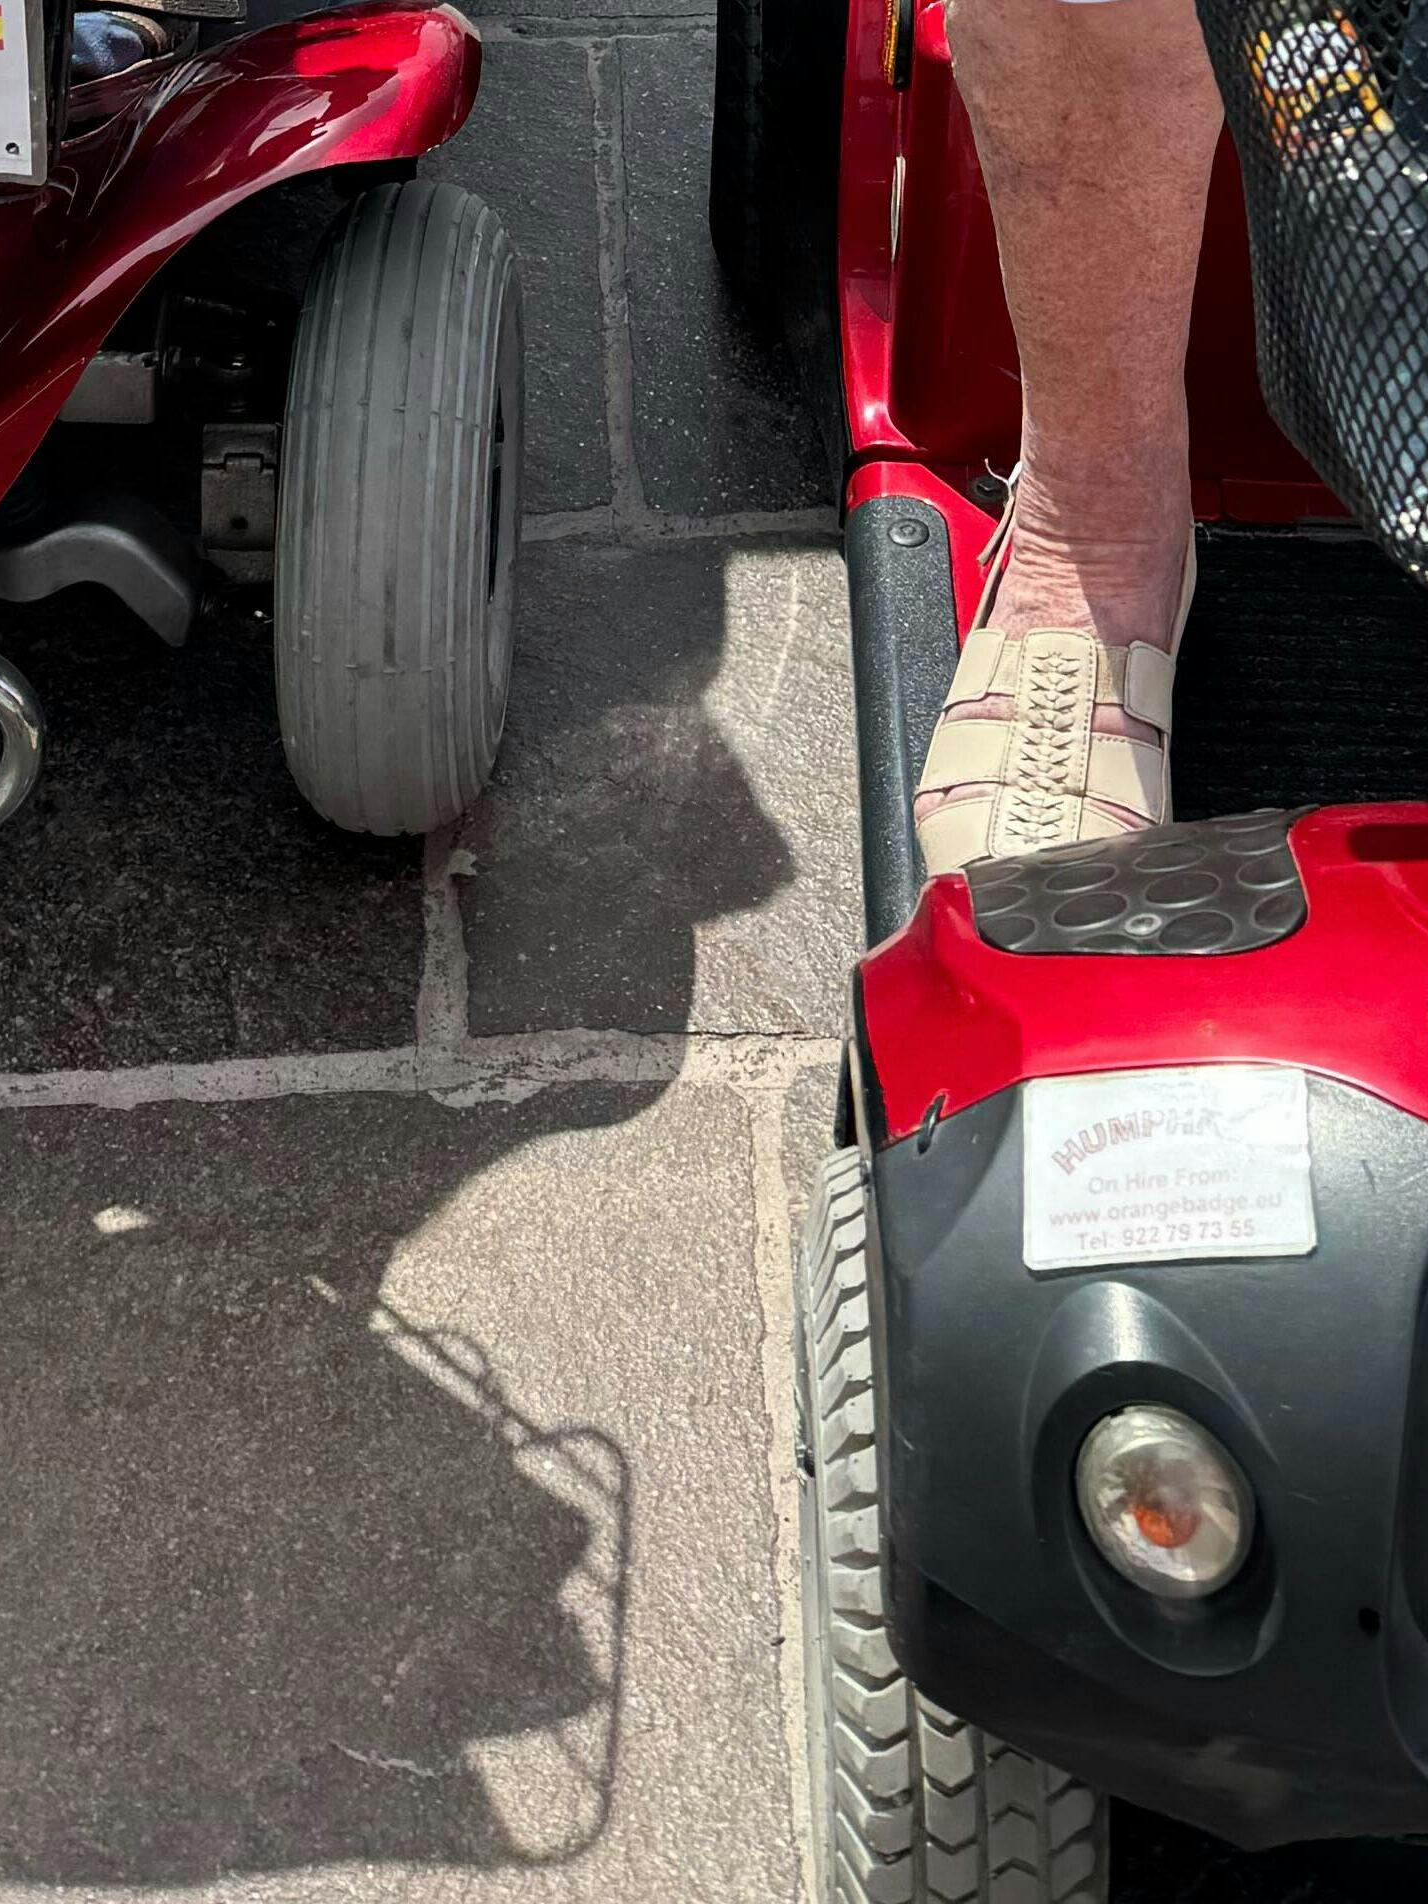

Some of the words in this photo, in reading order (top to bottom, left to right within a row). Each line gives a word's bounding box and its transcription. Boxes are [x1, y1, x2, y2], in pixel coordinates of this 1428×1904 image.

[1088, 1175, 1118, 1195] On
[1126, 1170, 1169, 1190] Hire
[1175, 1166, 1238, 1188] From:
[1048, 1191, 1281, 1226] www.orangebadge.eu
[1123, 1226, 1160, 1247] 922
[1166, 1223, 1191, 1243] 79
[1198, 1221, 1222, 1240] 73
[1229, 1218, 1256, 1237] 55
